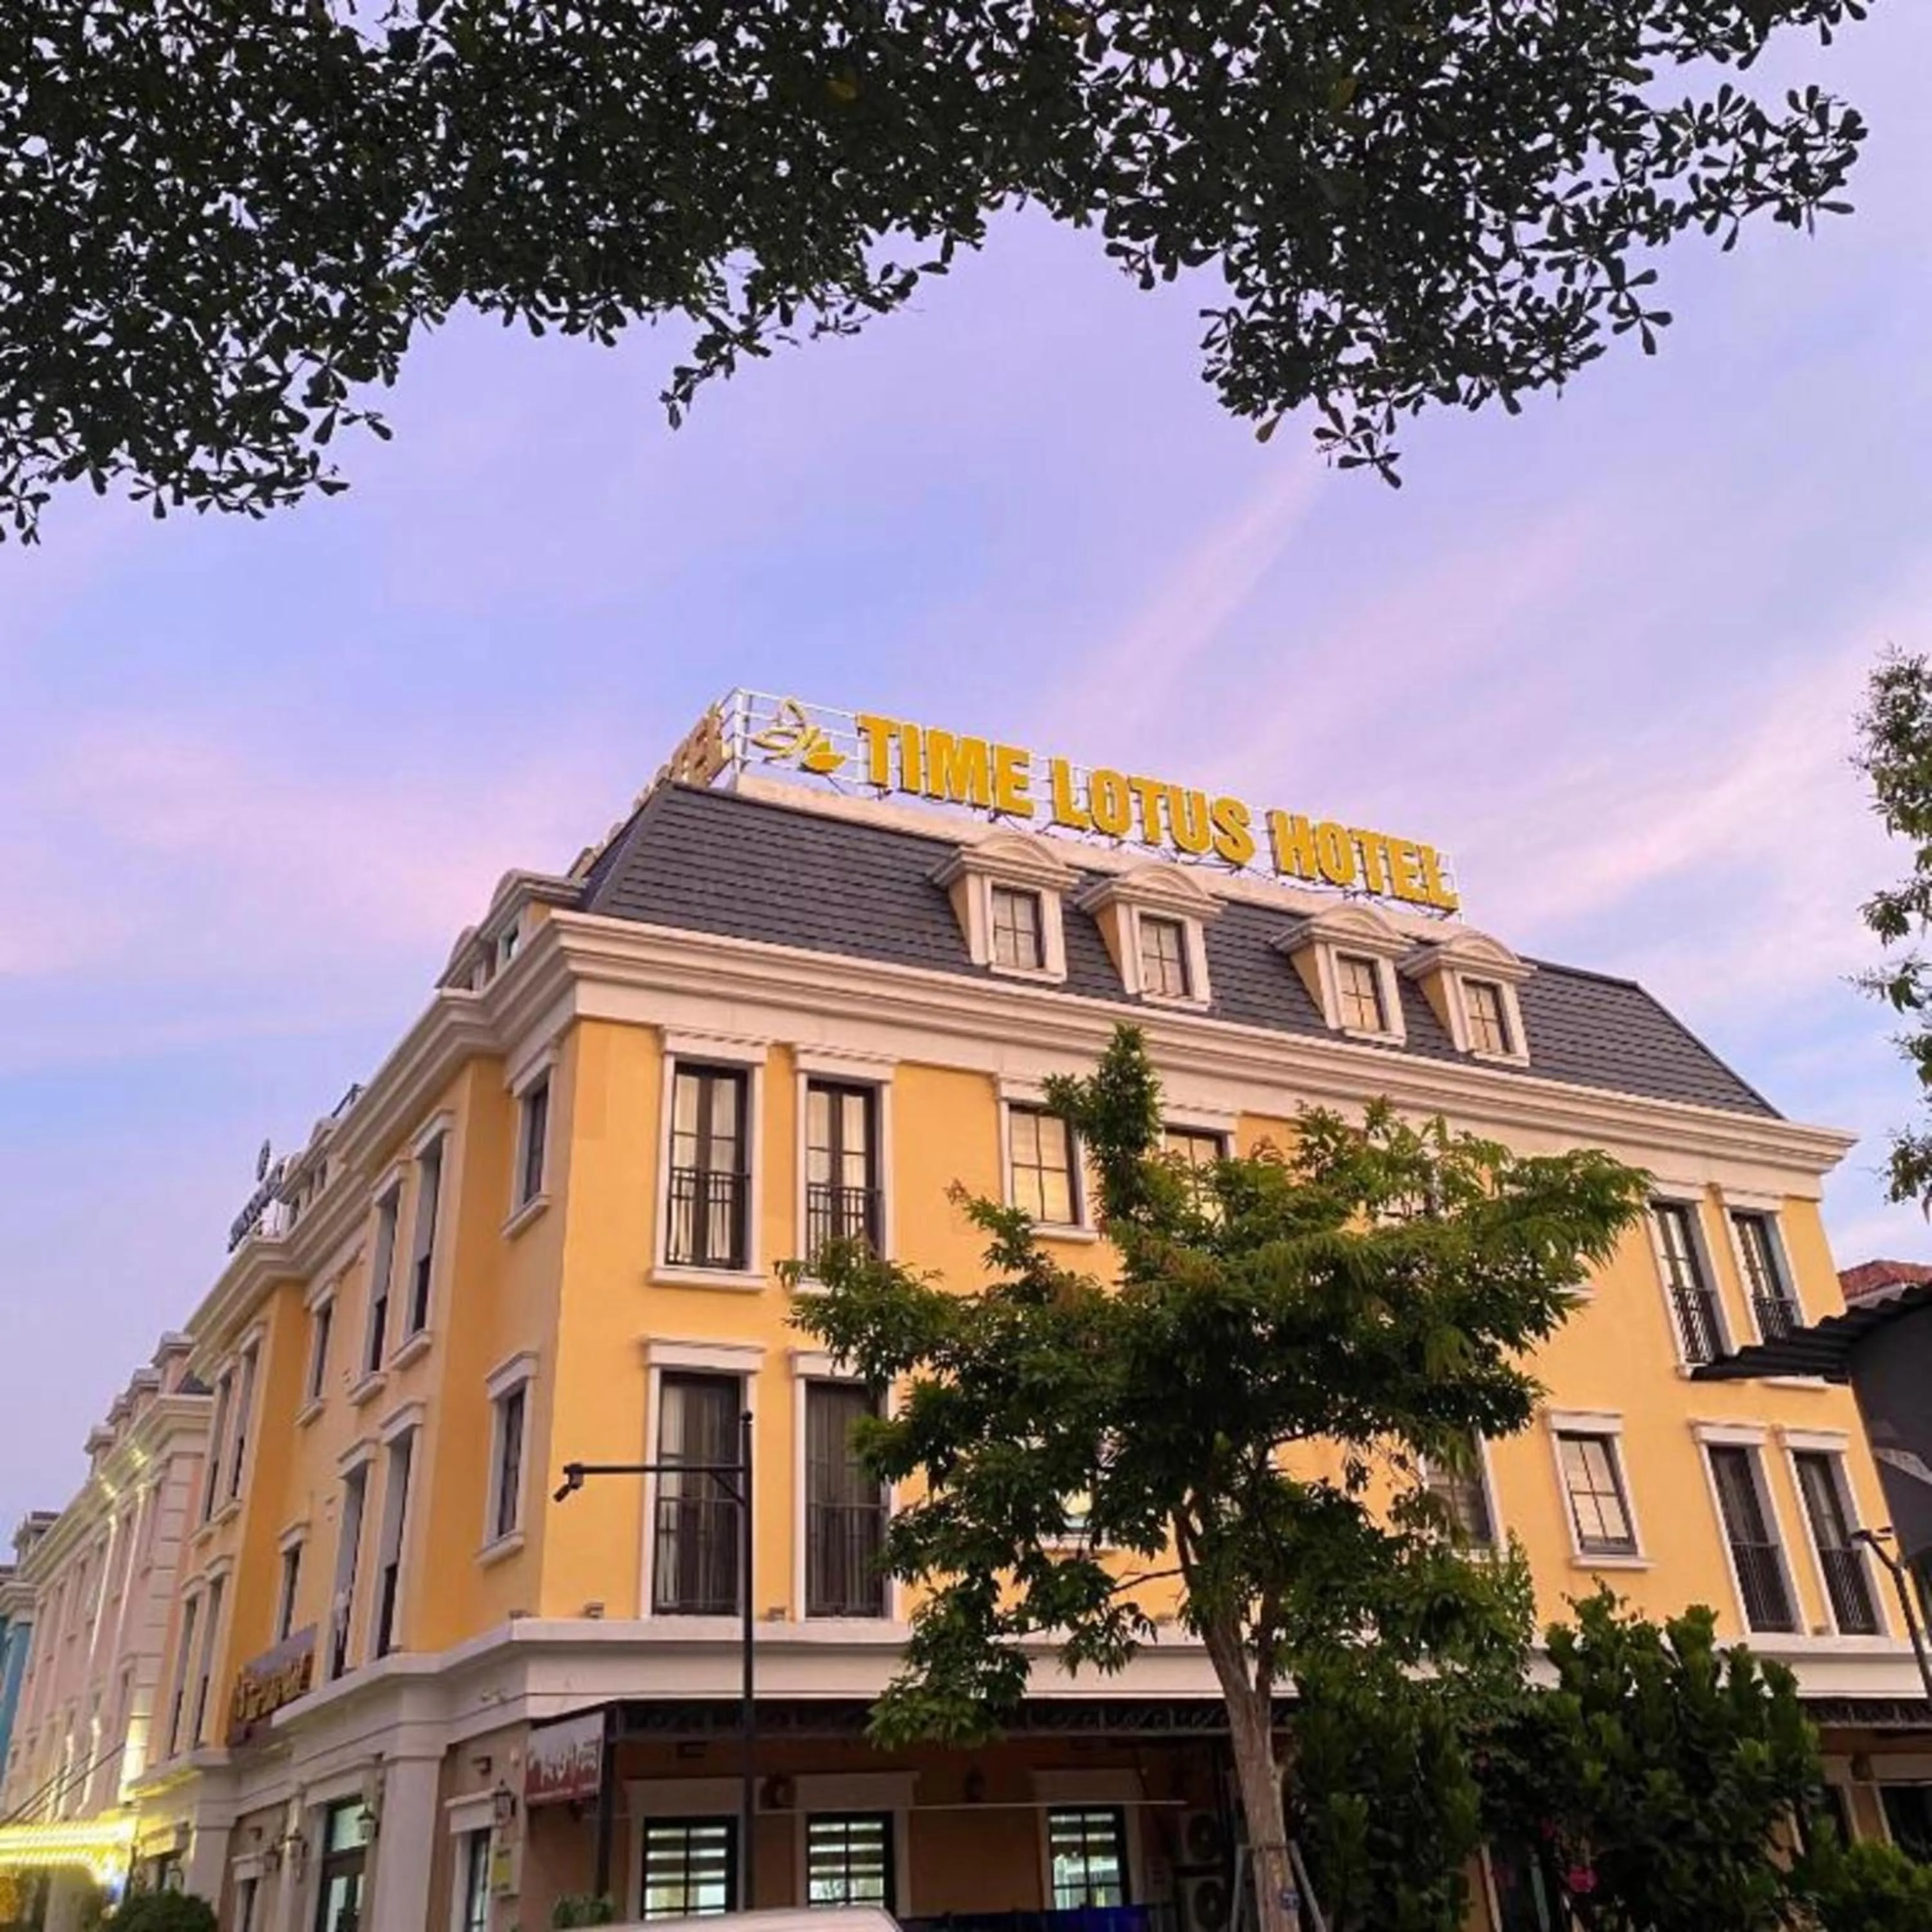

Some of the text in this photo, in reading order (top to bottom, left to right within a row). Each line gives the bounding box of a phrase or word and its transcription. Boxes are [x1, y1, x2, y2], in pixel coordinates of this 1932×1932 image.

[857, 714, 1459, 913] TIME LOTUS HOTEL
